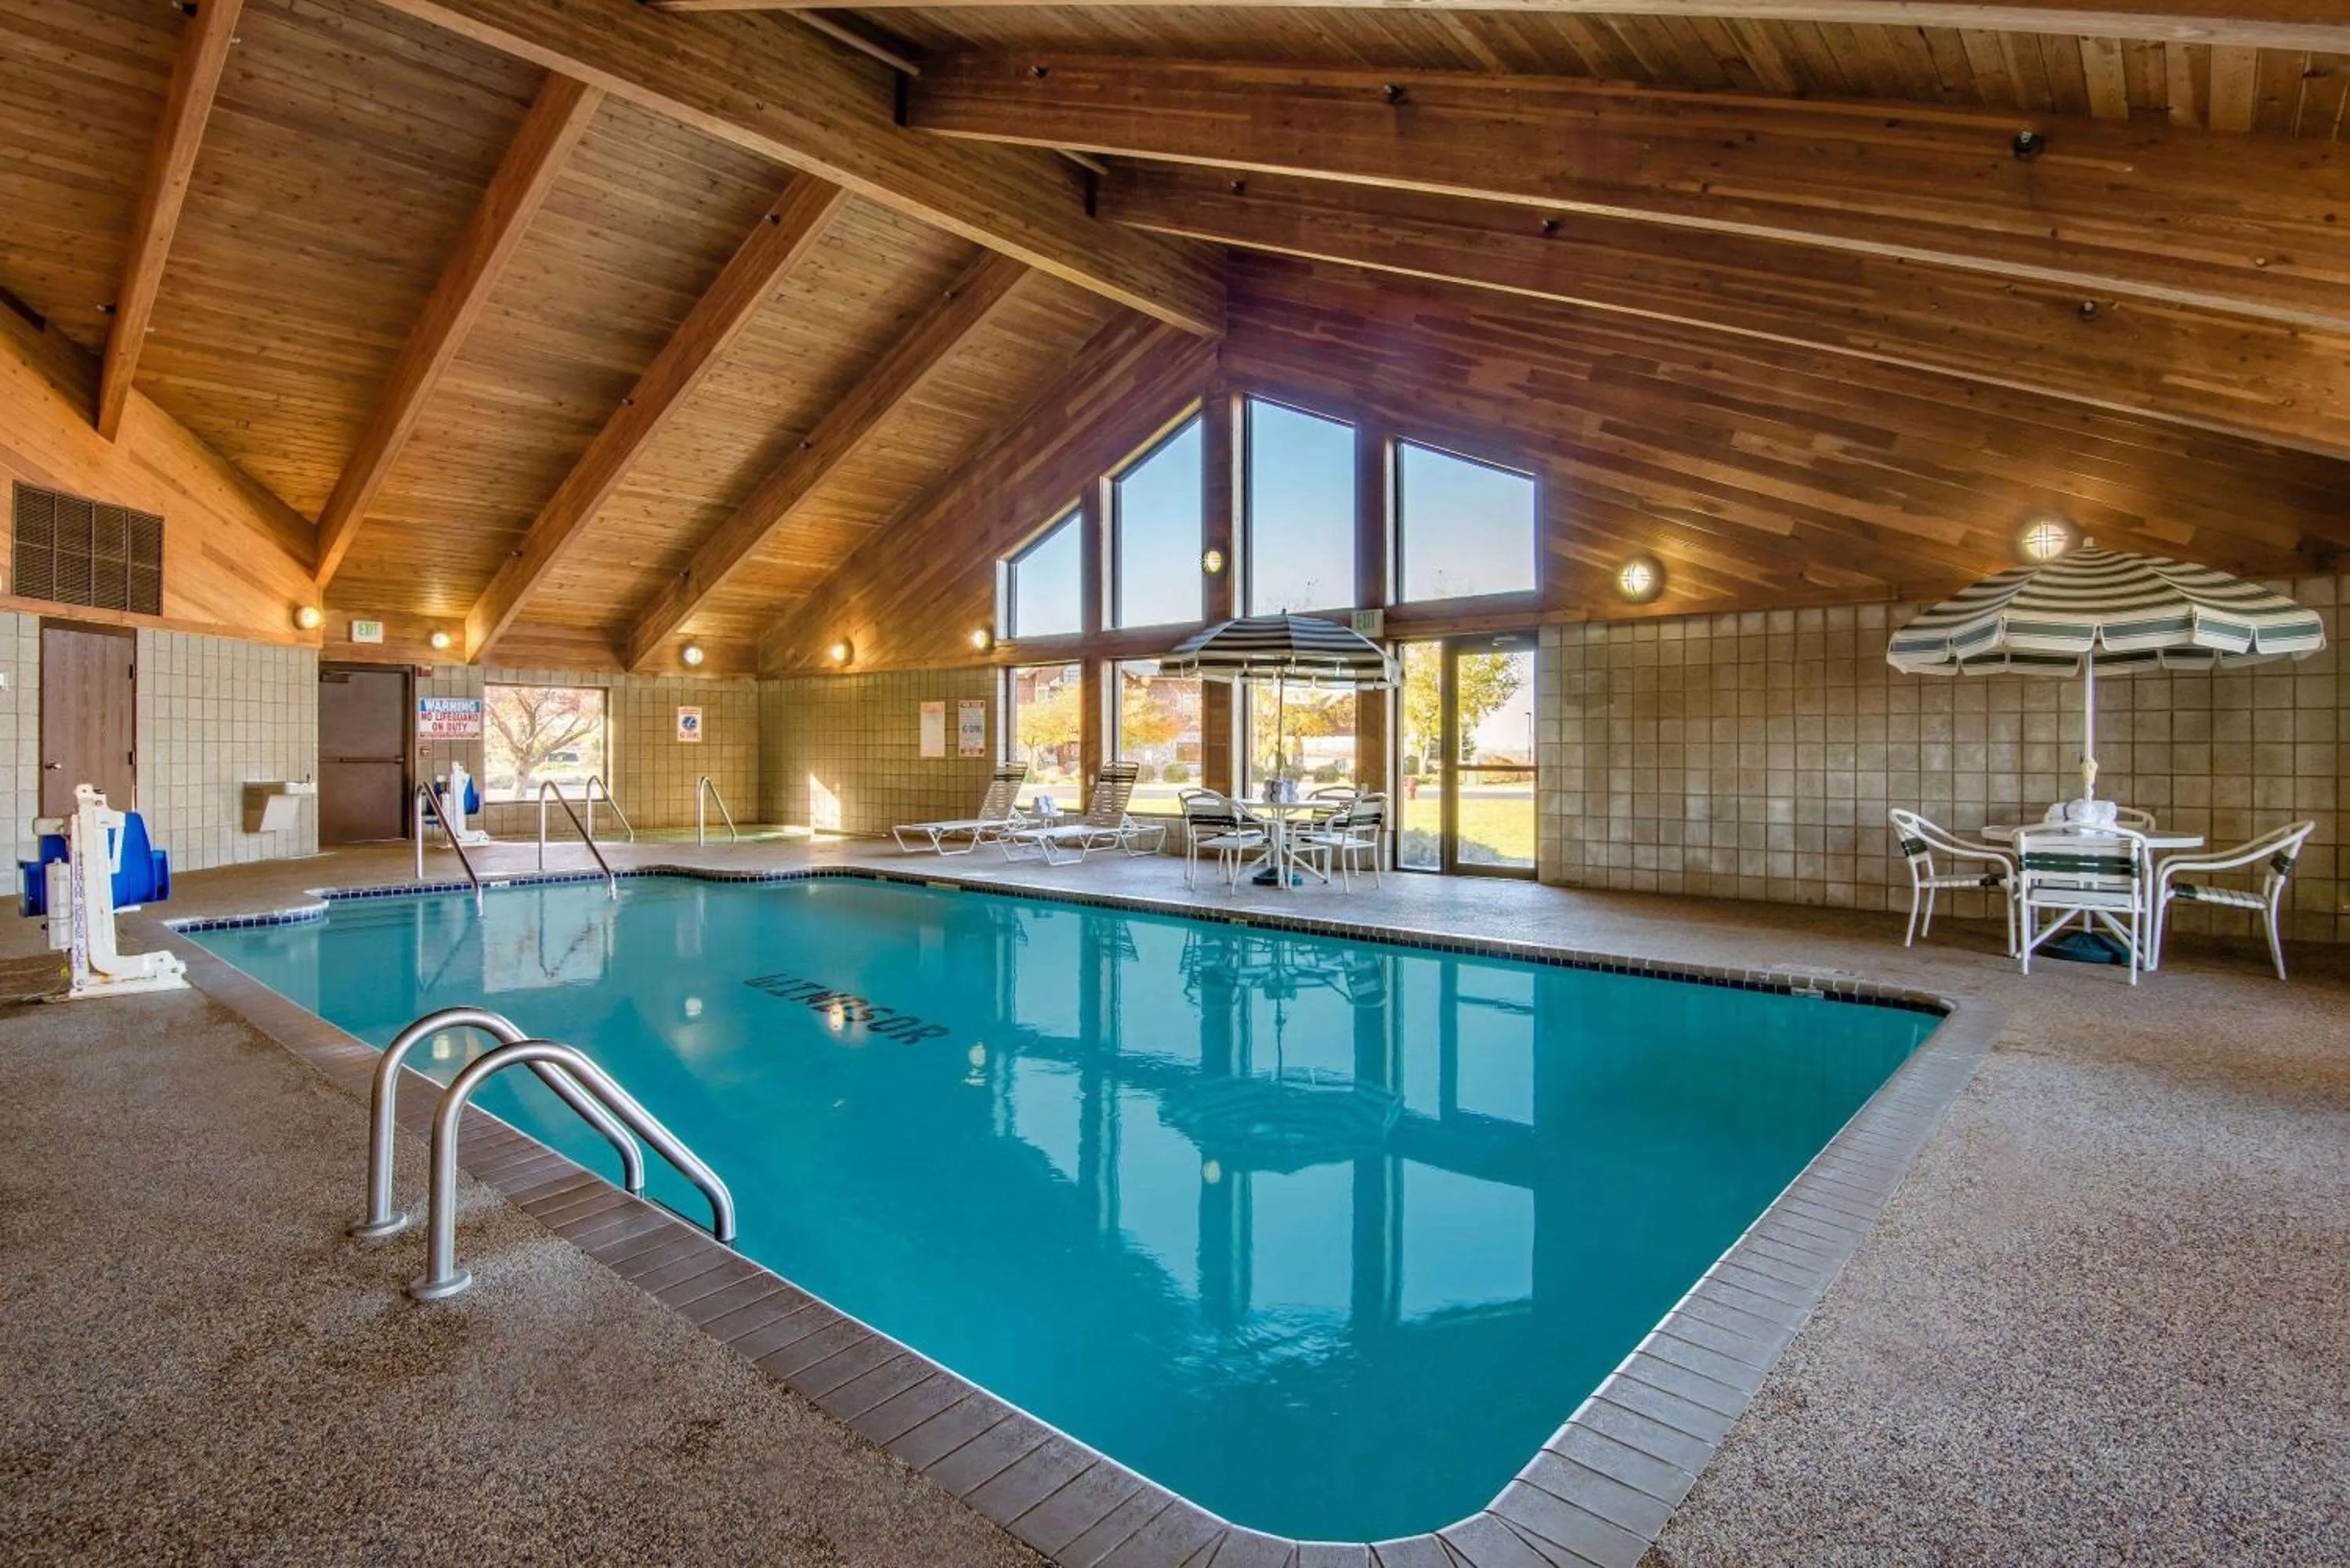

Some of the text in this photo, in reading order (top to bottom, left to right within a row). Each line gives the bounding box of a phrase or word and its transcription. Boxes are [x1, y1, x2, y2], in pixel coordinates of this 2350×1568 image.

[1356, 612, 1376, 630] EXIT
[358, 623, 378, 636] EXIT
[424, 699, 476, 712] WARNING
[421, 711, 479, 721] NO LIFEGUARD
[432, 721, 468, 732] ON DUTY
